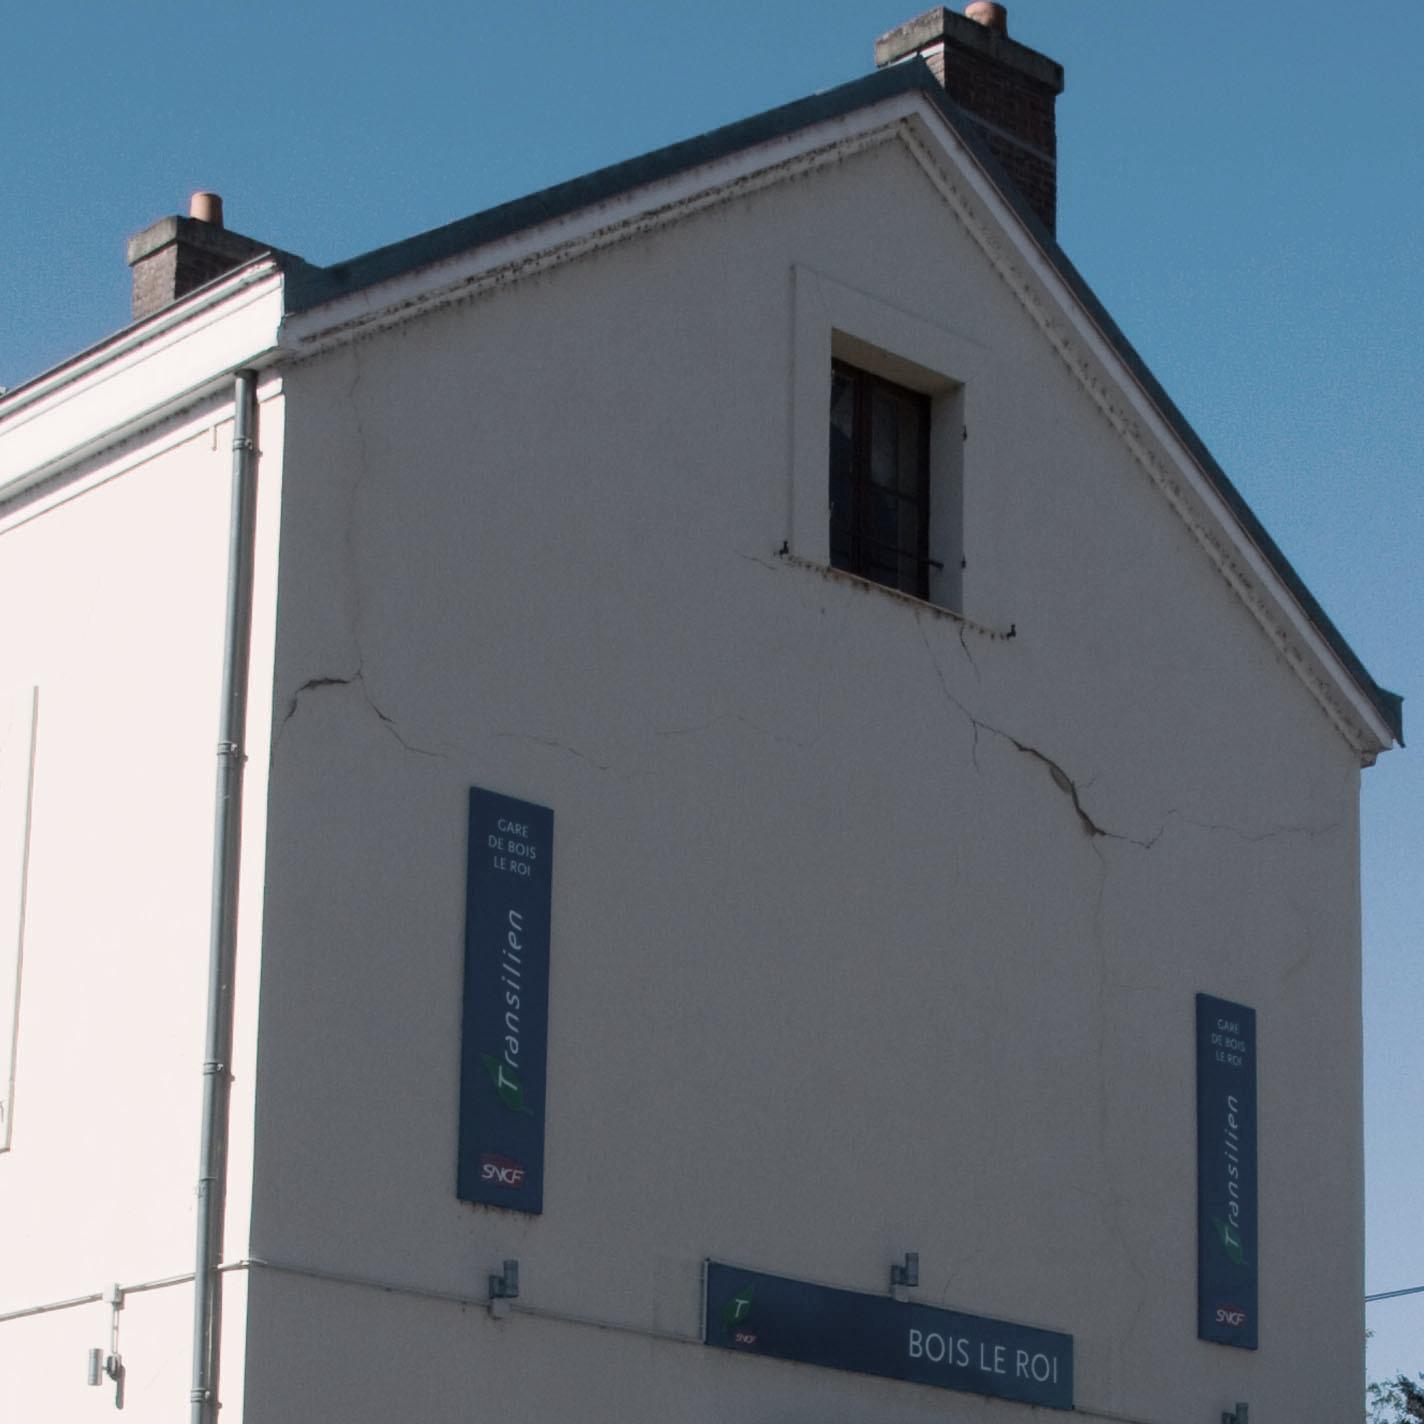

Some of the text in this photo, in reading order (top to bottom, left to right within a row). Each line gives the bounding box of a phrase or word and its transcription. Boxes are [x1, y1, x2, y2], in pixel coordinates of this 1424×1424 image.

[497, 818, 529, 839] GARE
[488, 834, 537, 860] DE BOIS
[493, 855, 531, 877] LE ROI
[498, 909, 525, 1093] Transilien
[1211, 1033, 1246, 1053] DE BOIS
[1215, 1050, 1225, 1063] LE
[481, 1162, 526, 1185] SNCF
[1224, 1095, 1240, 1248] Transilien
[1215, 1310, 1246, 1326] SNCF
[909, 1328, 1058, 1384] BOIS LE ROI
